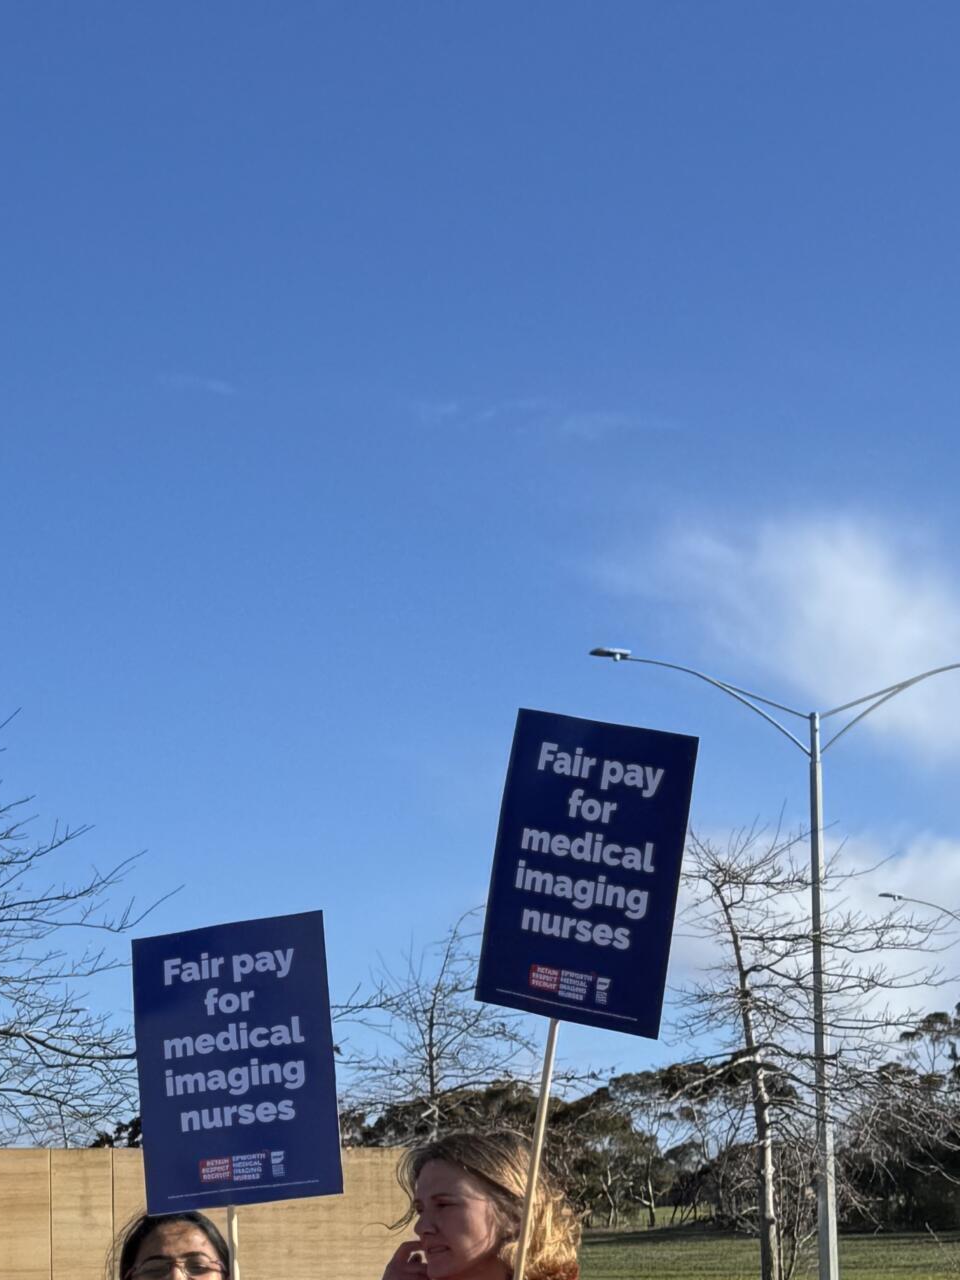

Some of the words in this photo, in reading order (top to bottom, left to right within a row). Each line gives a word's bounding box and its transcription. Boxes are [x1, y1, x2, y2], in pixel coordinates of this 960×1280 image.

[537, 742, 597, 779] Fair
[600, 760, 665, 798] pay
[568, 789, 618, 824] for
[521, 827, 655, 873] medical
[514, 860, 649, 920] imaging
[521, 909, 631, 950] nurses
[163, 953, 225, 986] Fair
[231, 948, 295, 982] pay
[203, 988, 255, 1015] for
[163, 1016, 306, 1060] medical
[164, 1058, 306, 1096] imaging
[180, 1100, 296, 1133] nurses
